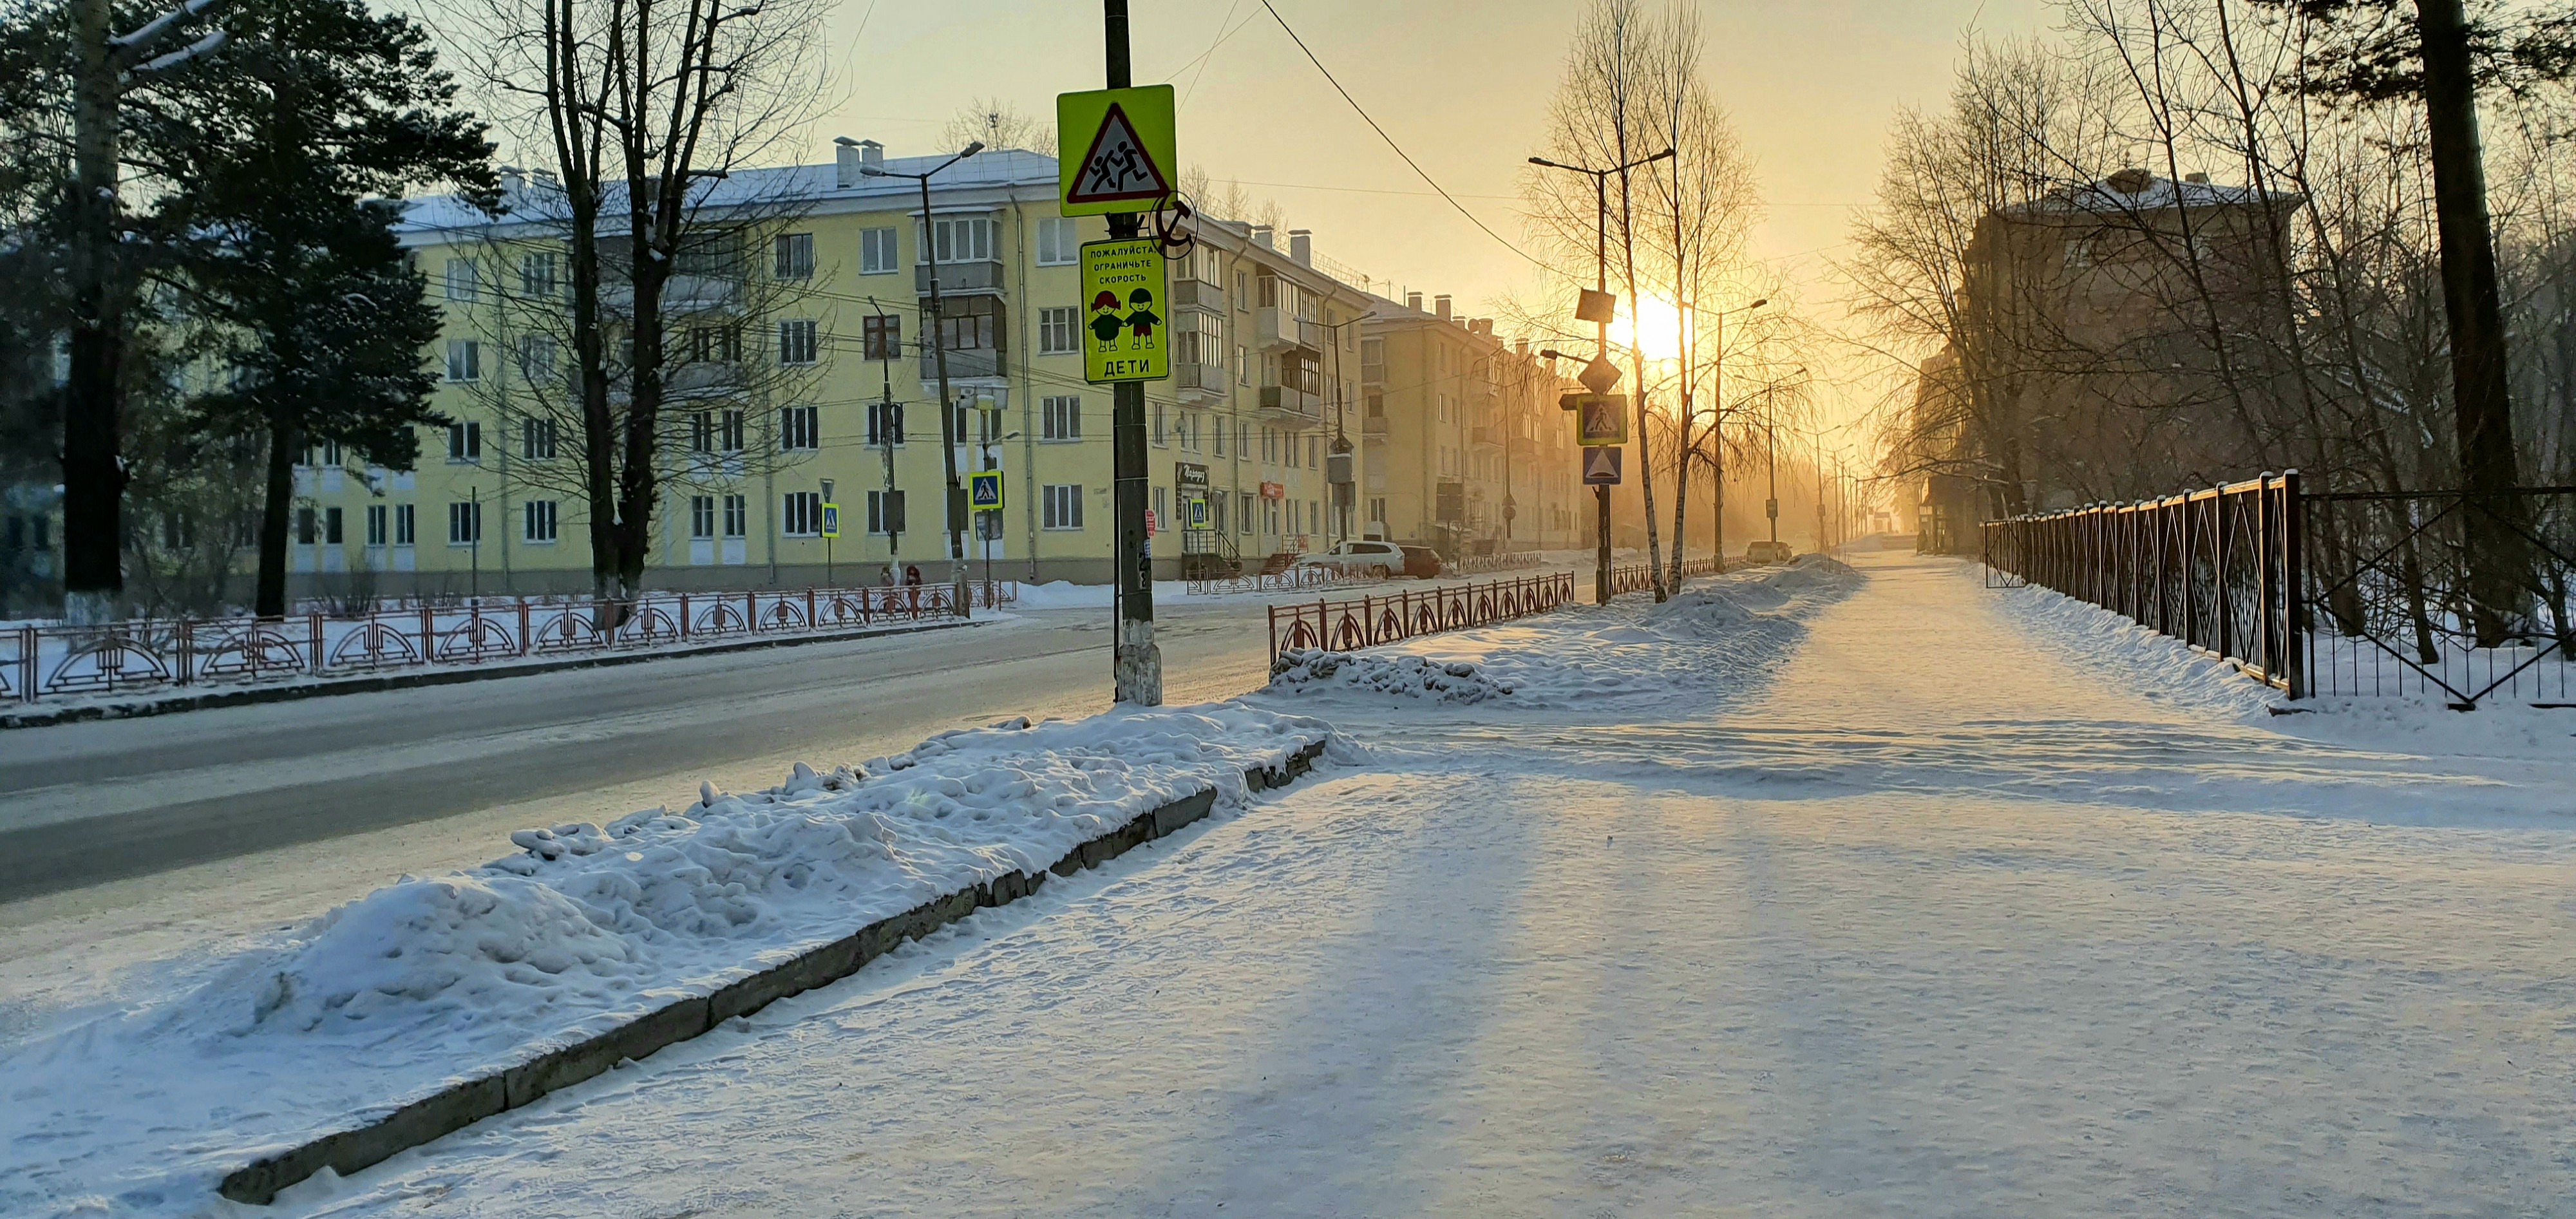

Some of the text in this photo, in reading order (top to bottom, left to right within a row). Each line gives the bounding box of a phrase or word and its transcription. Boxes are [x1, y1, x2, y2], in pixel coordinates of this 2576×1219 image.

[1094, 260, 1151, 271] ОГРАНИЧЬТЕ
[1099, 274, 1146, 284] СКОРОСТЬ
[1104, 359, 1150, 377] ДЕТИ
